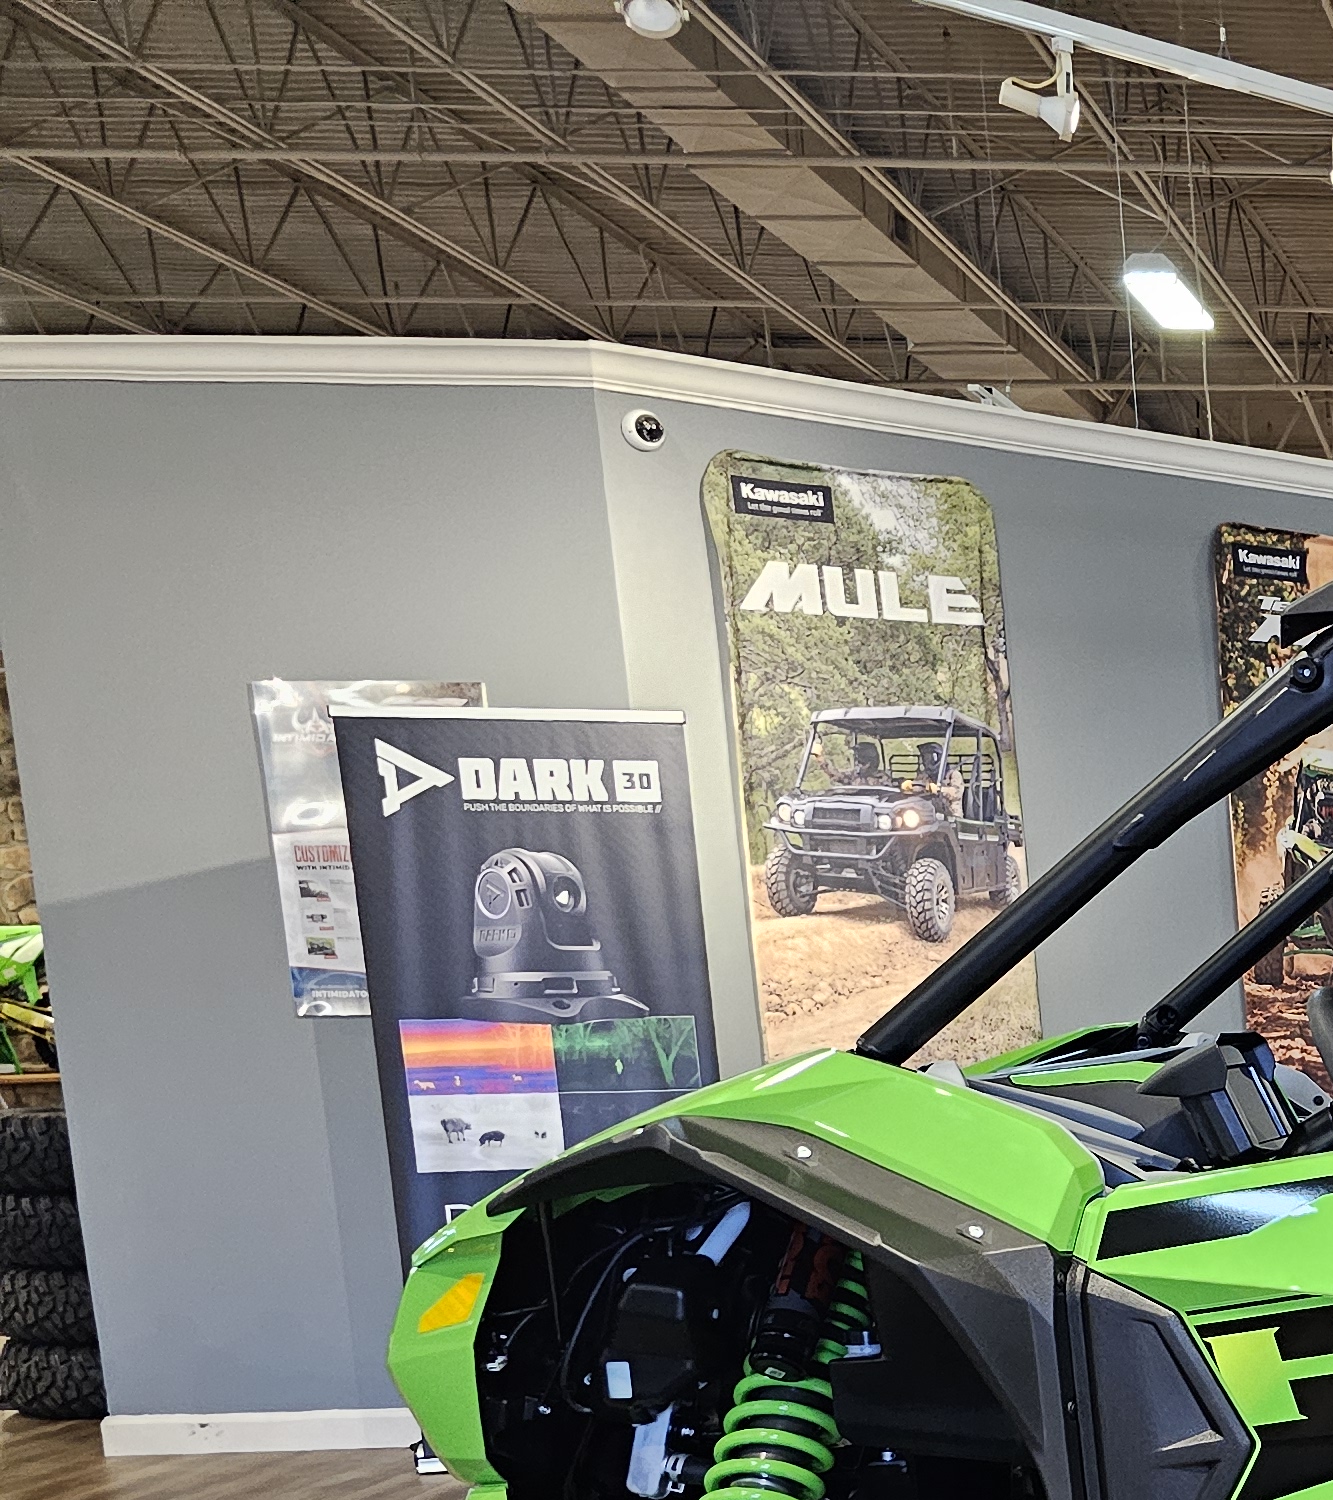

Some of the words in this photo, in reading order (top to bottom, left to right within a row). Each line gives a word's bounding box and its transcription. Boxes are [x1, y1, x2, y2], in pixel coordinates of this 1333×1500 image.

[740, 482, 825, 507] Kawasaki
[1238, 549, 1300, 570] Kawasaki
[740, 561, 984, 626] MULE
[458, 757, 609, 802] DARK
[463, 802, 490, 812] PUSH
[490, 803, 508, 812] THE
[508, 803, 564, 813] BOUNDARIES
[565, 804, 577, 813] OF
[578, 804, 601, 813] WHAT
[602, 805, 612, 813] IS
[613, 805, 654, 813] POSSIBLE
[294, 845, 350, 863] CUSTOMIZ
[311, 990, 369, 999] INTIMIDATO
